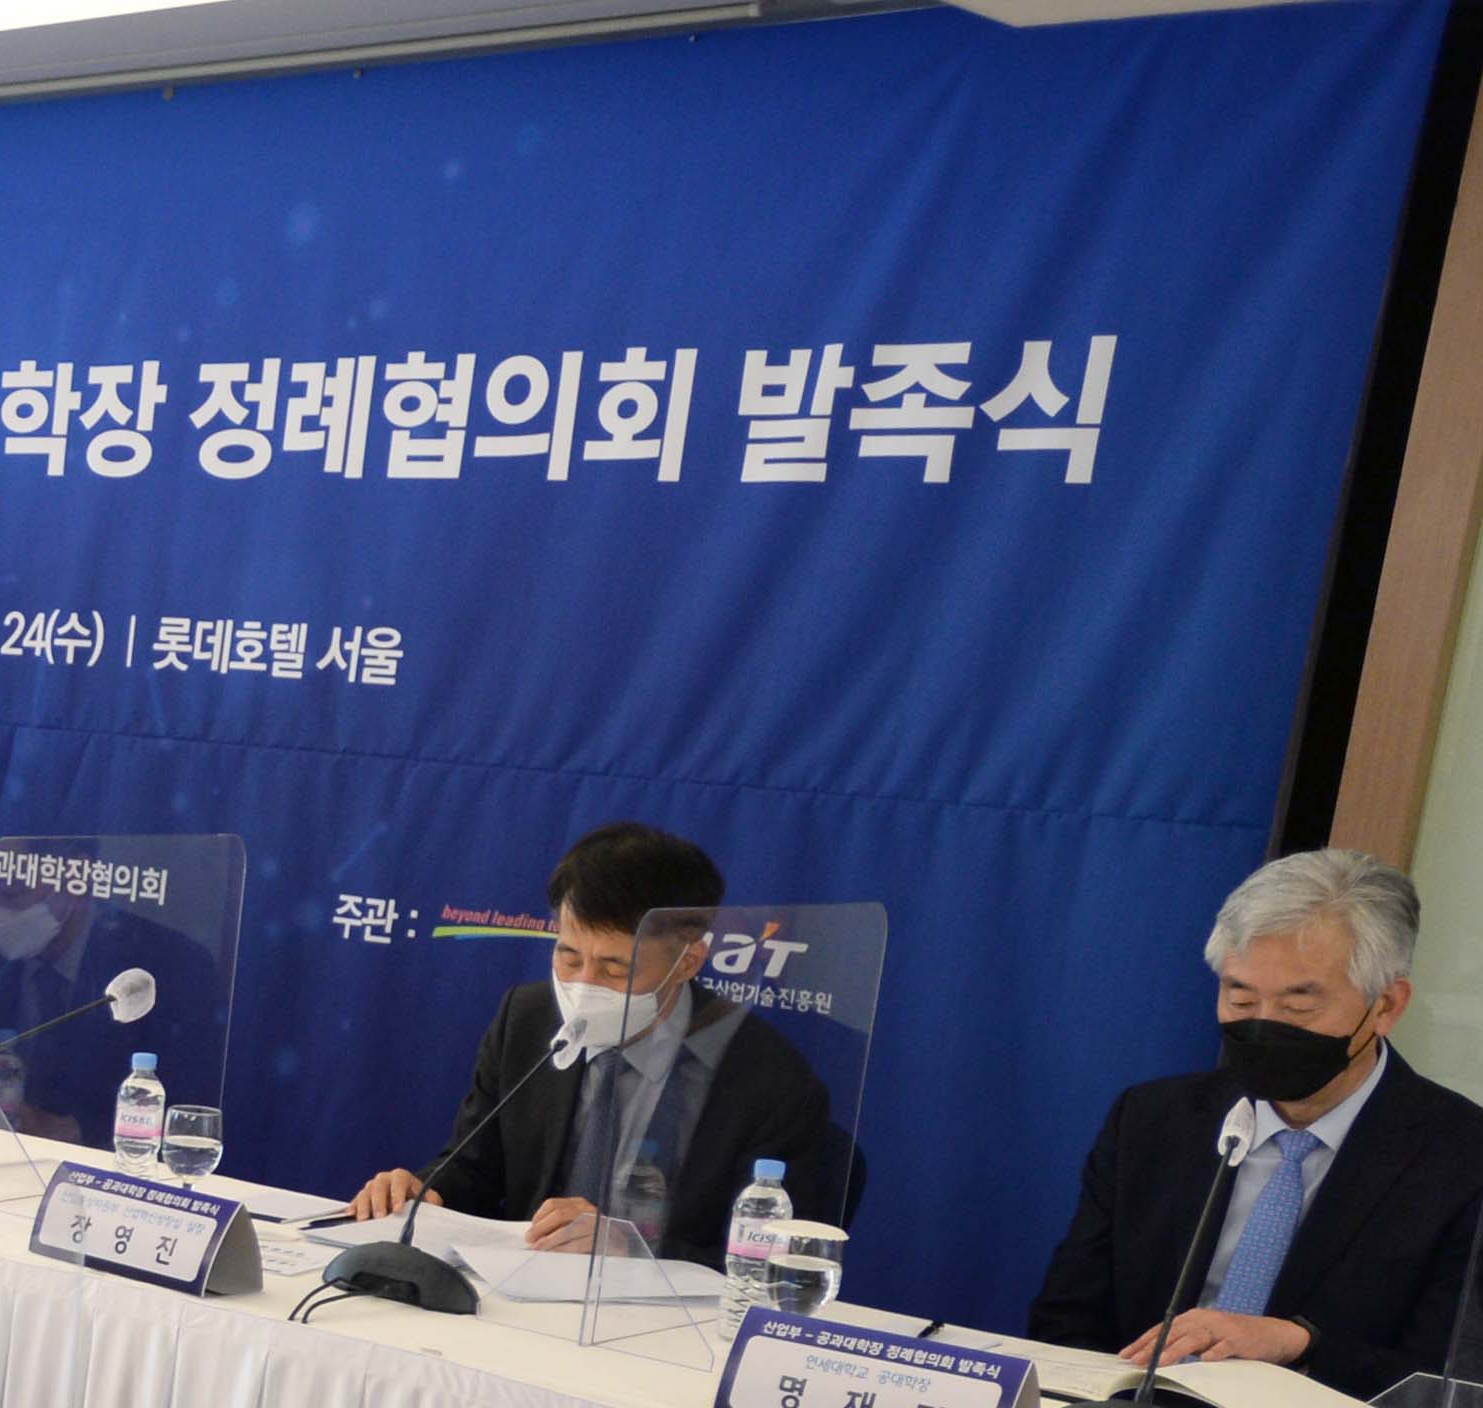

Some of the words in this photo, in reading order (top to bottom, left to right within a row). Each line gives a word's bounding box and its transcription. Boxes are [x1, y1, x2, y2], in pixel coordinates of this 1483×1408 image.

[189, 347, 697, 481] 정례협의회
[738, 336, 1117, 483] 발족식
[1, 609, 104, 666] 24(수)
[153, 617, 307, 678] 롯데호텔
[316, 626, 403, 685] 서울
[332, 894, 399, 944] 주관
[441, 903, 491, 924] beyond
[70, 1213, 92, 1244] 장
[114, 1224, 135, 1255] 영
[155, 1236, 179, 1267] 진
[763, 1320, 803, 1340] 산업부
[817, 1331, 884, 1356] 공과대학장
[887, 1345, 956, 1370] 정례협의회
[958, 1358, 1002, 1380] 발족식
